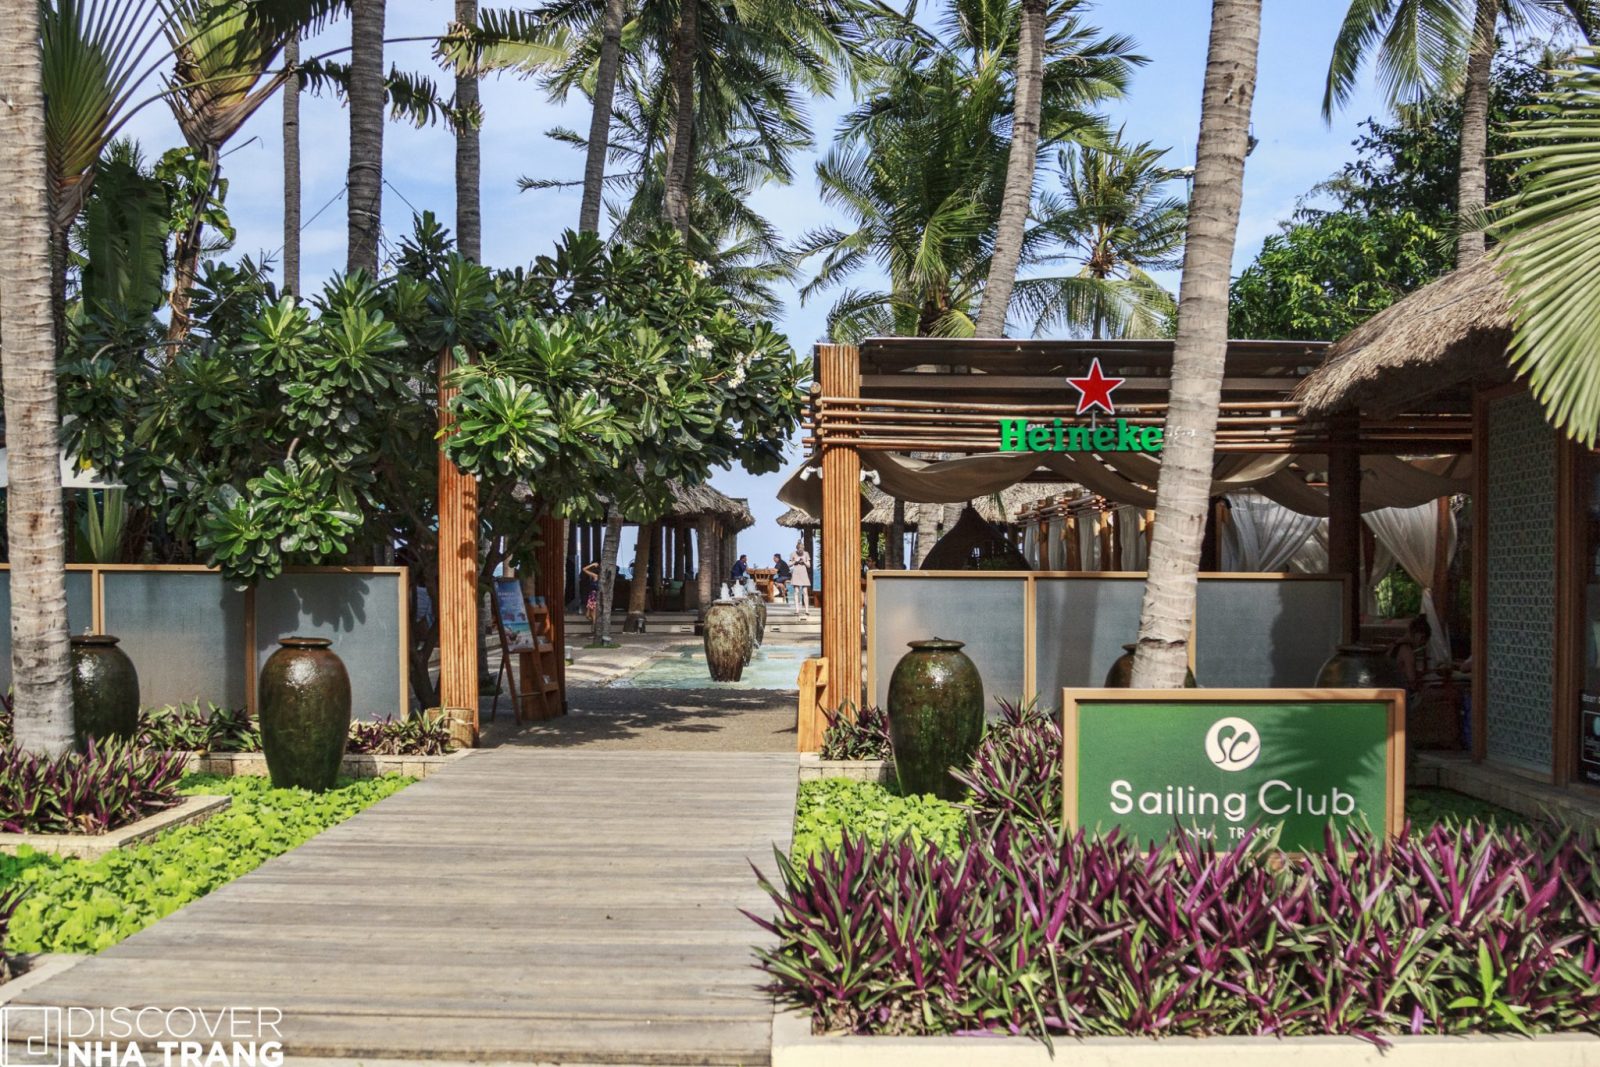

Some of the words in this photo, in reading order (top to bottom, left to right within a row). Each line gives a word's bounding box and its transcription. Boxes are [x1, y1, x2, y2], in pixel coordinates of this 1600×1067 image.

[998, 417, 1164, 452] Heineke
[1109, 779, 1247, 822] Sailing
[1257, 779, 1356, 816] Club
